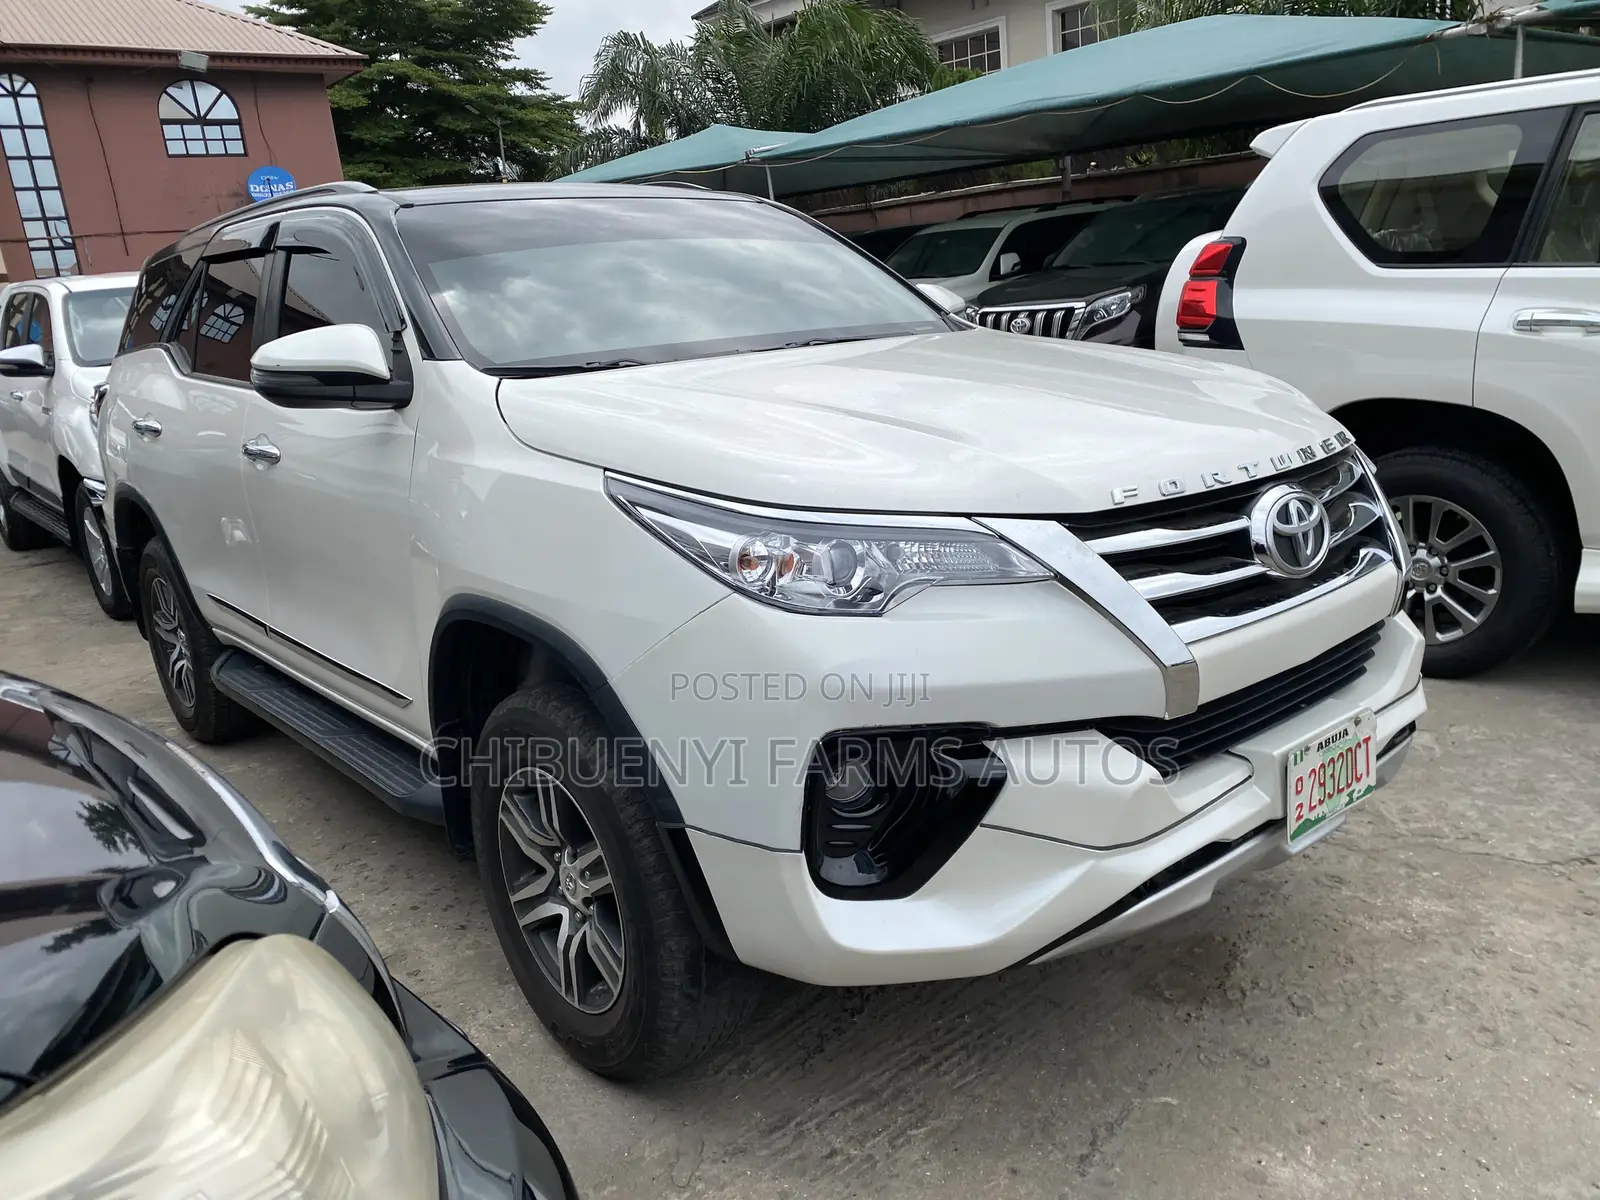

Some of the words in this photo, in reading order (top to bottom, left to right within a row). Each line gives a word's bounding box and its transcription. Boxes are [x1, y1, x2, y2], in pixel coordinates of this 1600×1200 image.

[1110, 430, 1351, 505] FORTUNER
[1308, 735, 1372, 813] 2932DCT
[1316, 728, 1349, 752] ABUJA
